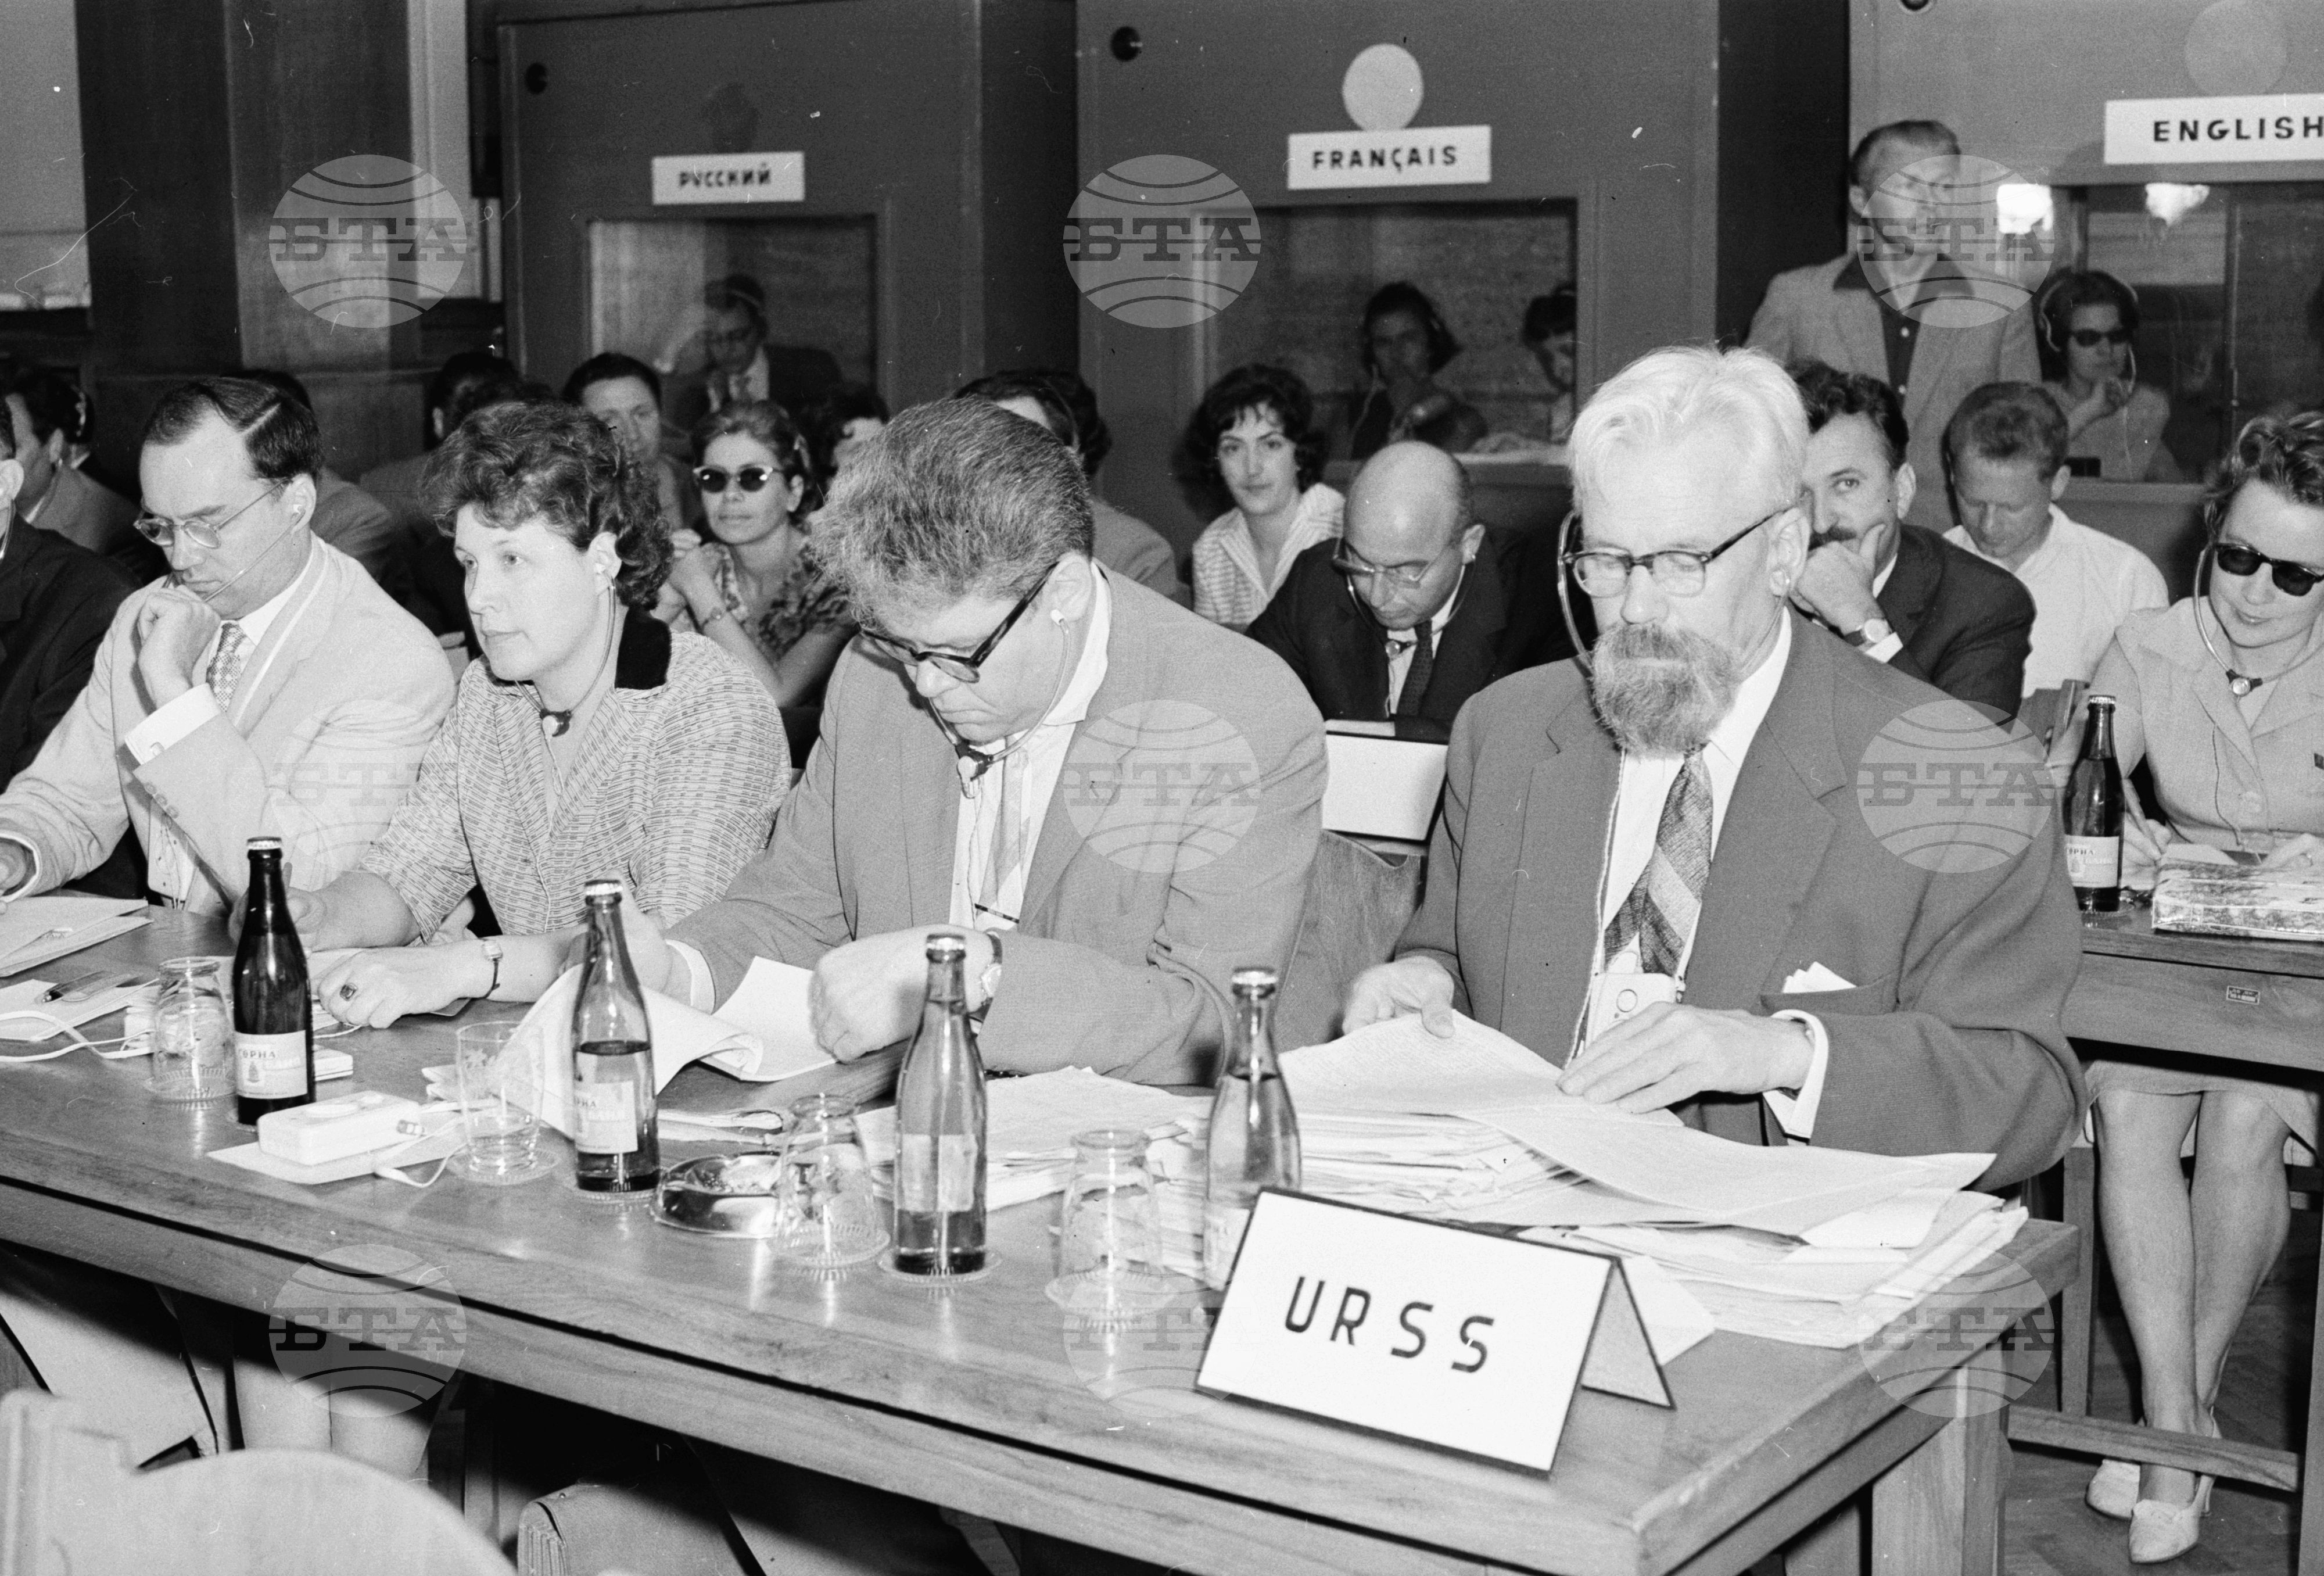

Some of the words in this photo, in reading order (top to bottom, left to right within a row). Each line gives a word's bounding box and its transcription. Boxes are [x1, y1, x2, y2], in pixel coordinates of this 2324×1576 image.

[2153, 116, 2324, 142] ENGLISH
[1312, 145, 1456, 174] FRANÇAIS
[679, 161, 771, 188] РУССКИЙ
[1284, 1276, 1495, 1373] URSS
